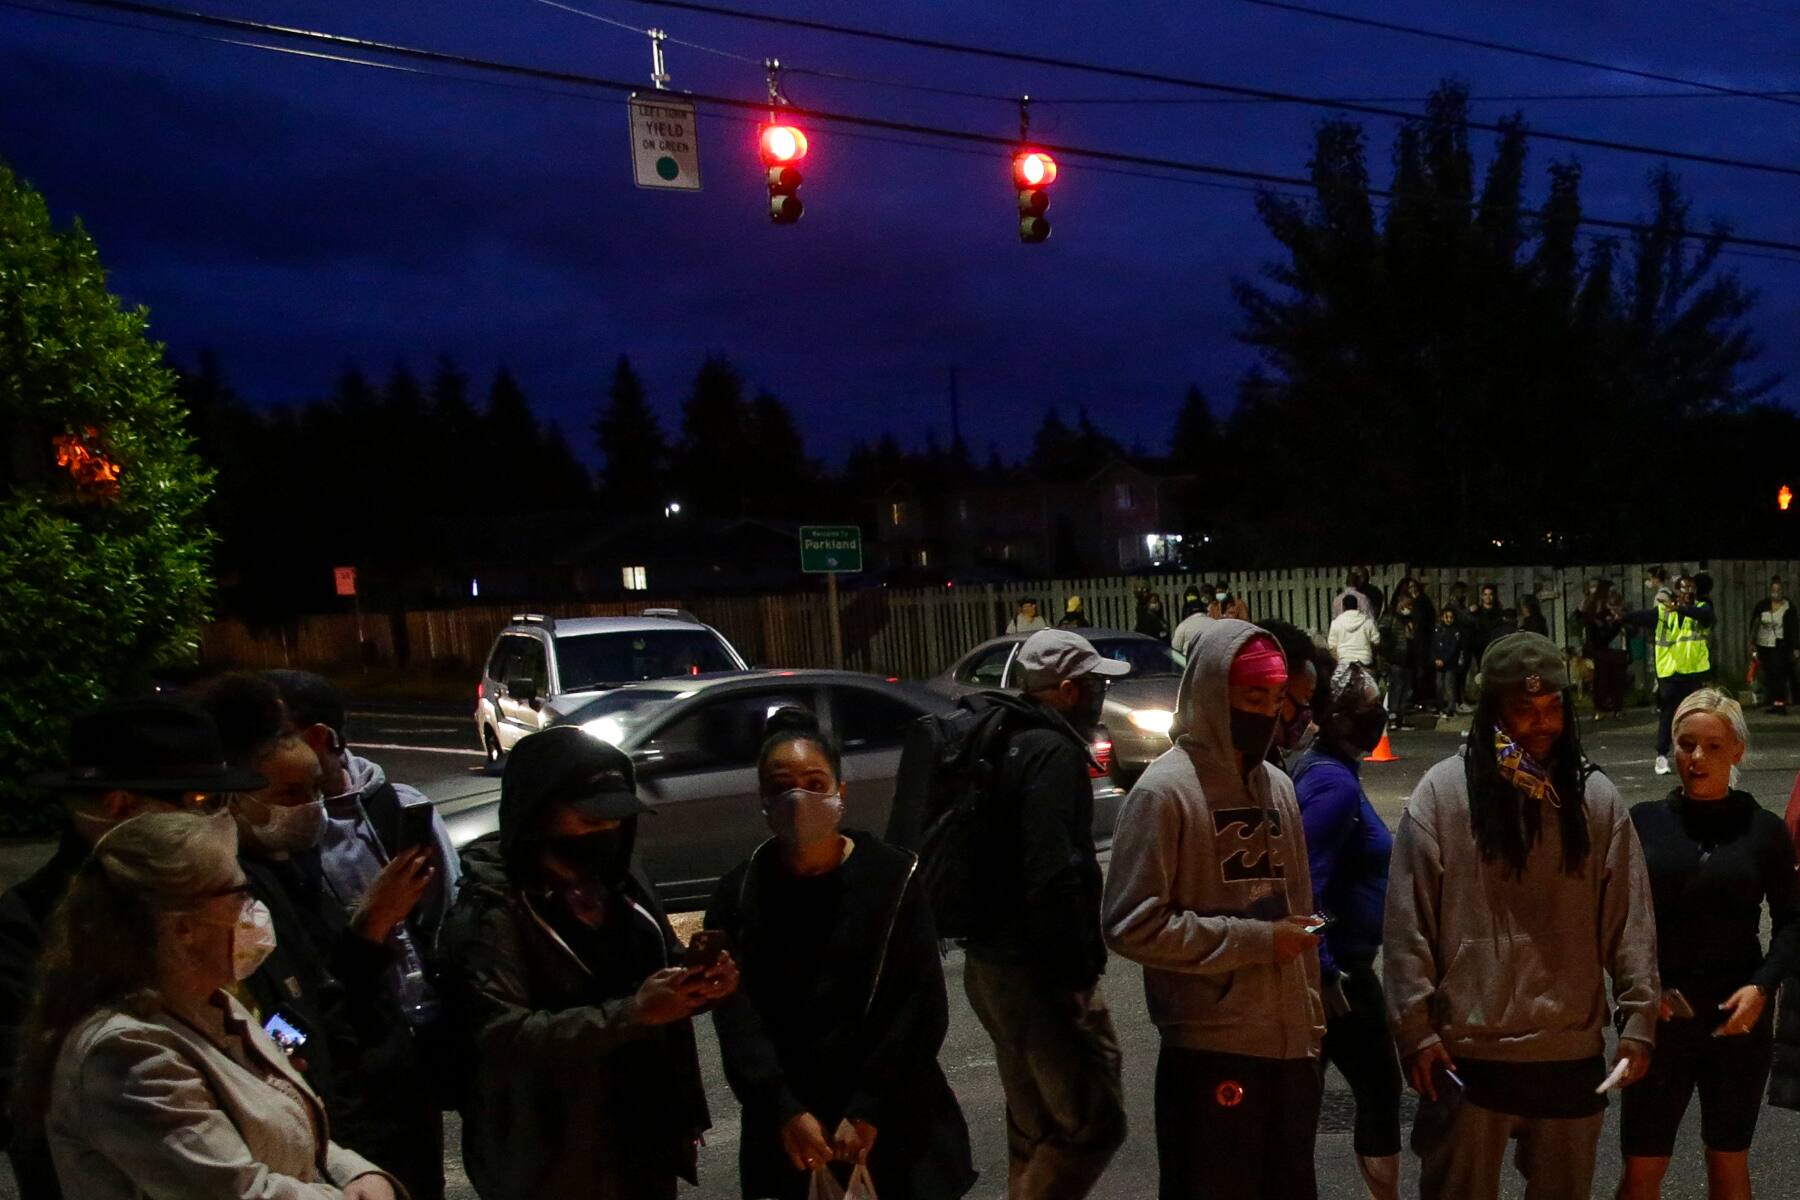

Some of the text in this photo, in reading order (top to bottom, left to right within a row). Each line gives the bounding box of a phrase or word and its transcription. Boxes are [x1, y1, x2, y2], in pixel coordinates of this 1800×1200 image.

[646, 121, 683, 137] YIELD
[643, 140, 689, 153] ON GREEN
[804, 539, 857, 550] Parkland
